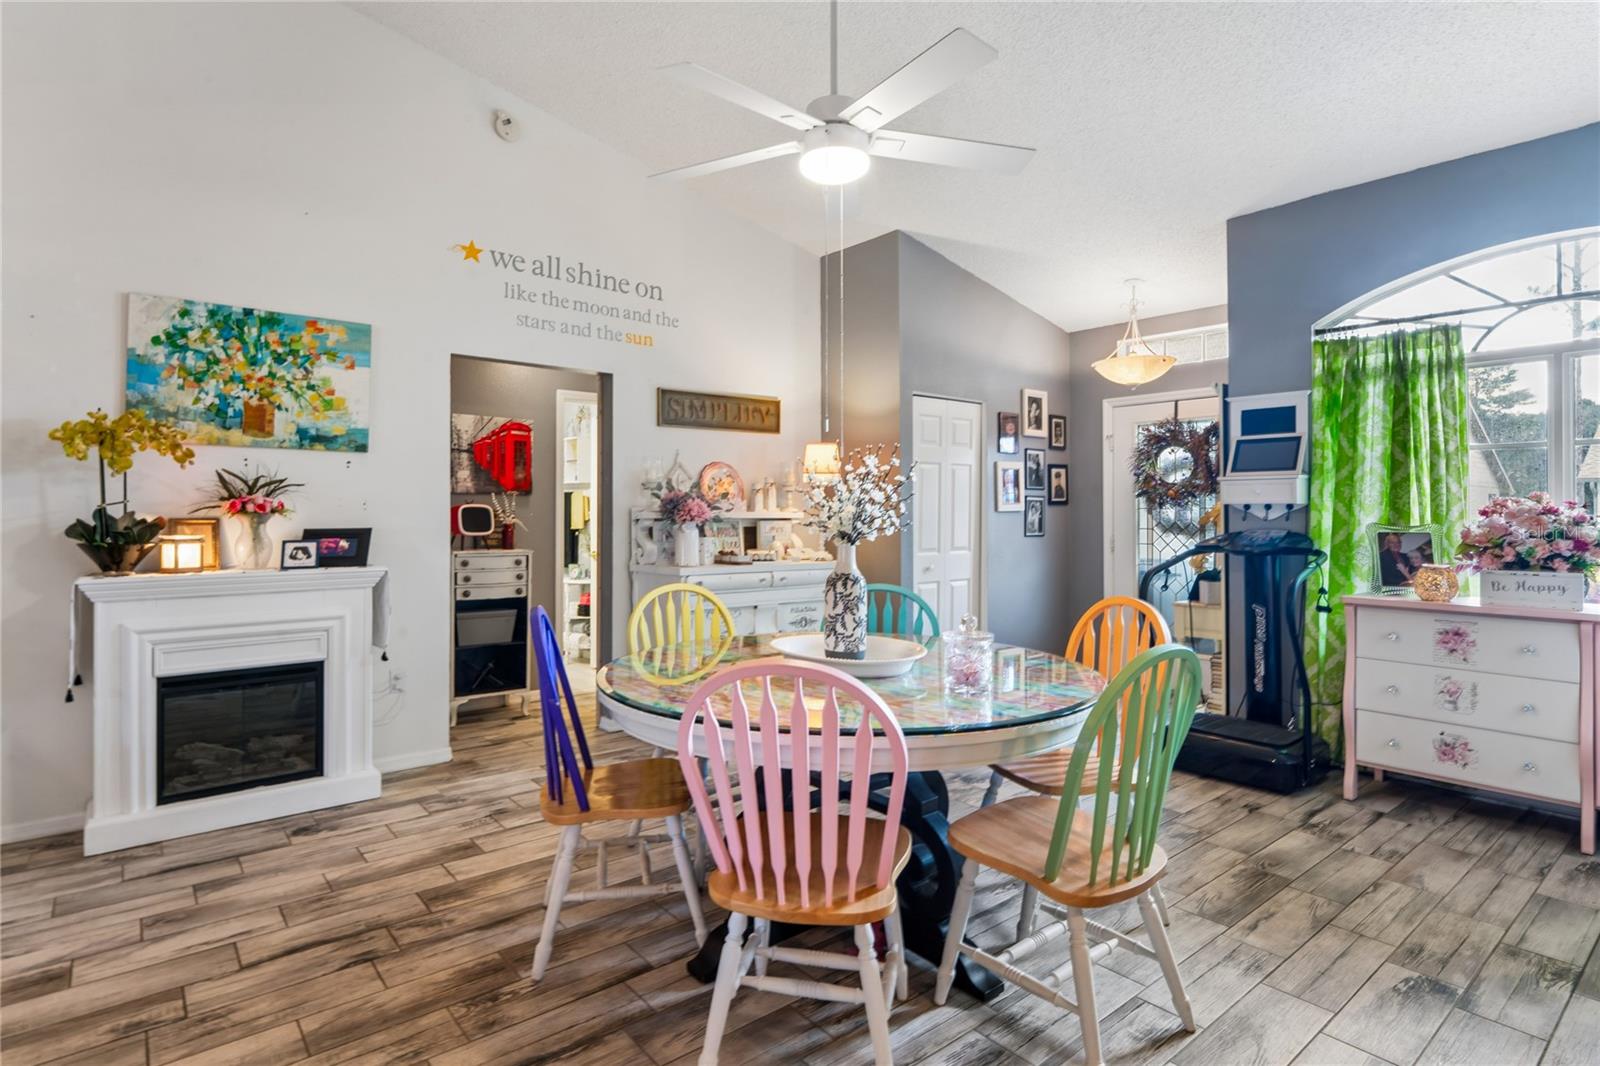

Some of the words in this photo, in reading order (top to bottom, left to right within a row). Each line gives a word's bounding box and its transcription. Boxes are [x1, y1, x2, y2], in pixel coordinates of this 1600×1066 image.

[490, 249, 526, 273] we
[532, 255, 562, 280] all
[566, 262, 630, 294] shine
[635, 280, 664, 302] on
[503, 281, 537, 304] like
[541, 291, 569, 309] the
[572, 299, 620, 319] moon
[623, 309, 652, 324] and
[655, 311, 680, 328] the
[516, 314, 556, 332] stars
[560, 322, 592, 339] and
[597, 325, 623, 342] the
[624, 331, 654, 347] sun
[1490, 580, 1509, 592] Be
[1515, 580, 1568, 596] Happy
